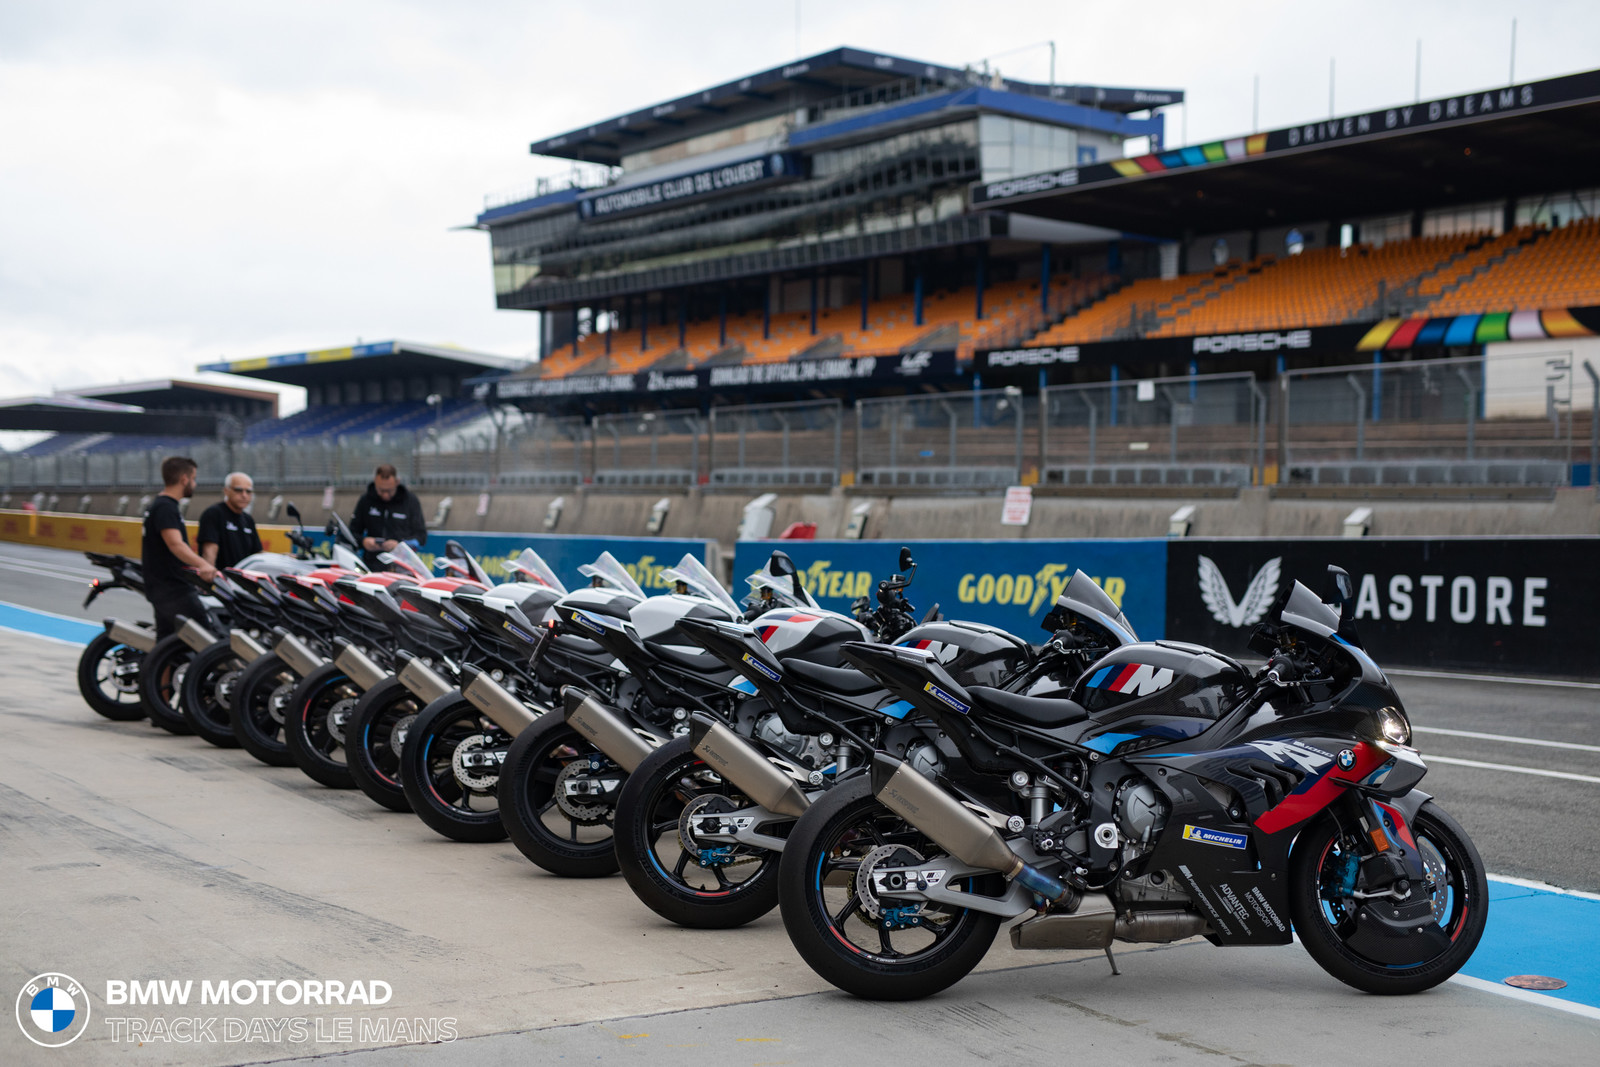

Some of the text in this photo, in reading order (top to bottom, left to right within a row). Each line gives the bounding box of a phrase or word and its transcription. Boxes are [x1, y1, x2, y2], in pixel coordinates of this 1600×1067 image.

[1288, 85, 1533, 146] DRIVEN BY DREAMS
[663, 178, 694, 199] CLUB
[694, 172, 712, 192] DE
[986, 168, 1079, 199] PORSCHE
[988, 346, 1080, 366] PORSCHE
[1193, 330, 1312, 354] PORSCHE
[958, 573, 1126, 609] GOODYR
[1329, 574, 1548, 626] ASTORE
[1119, 664, 1174, 696] M
[937, 692, 964, 710] MICHELIN
[1202, 833, 1243, 846] MICHELIN
[1219, 881, 1250, 920] ADVANTEC
[1243, 891, 1272, 928] MOTORSPORT
[1250, 886, 1286, 932] BMW MOTORRAD
